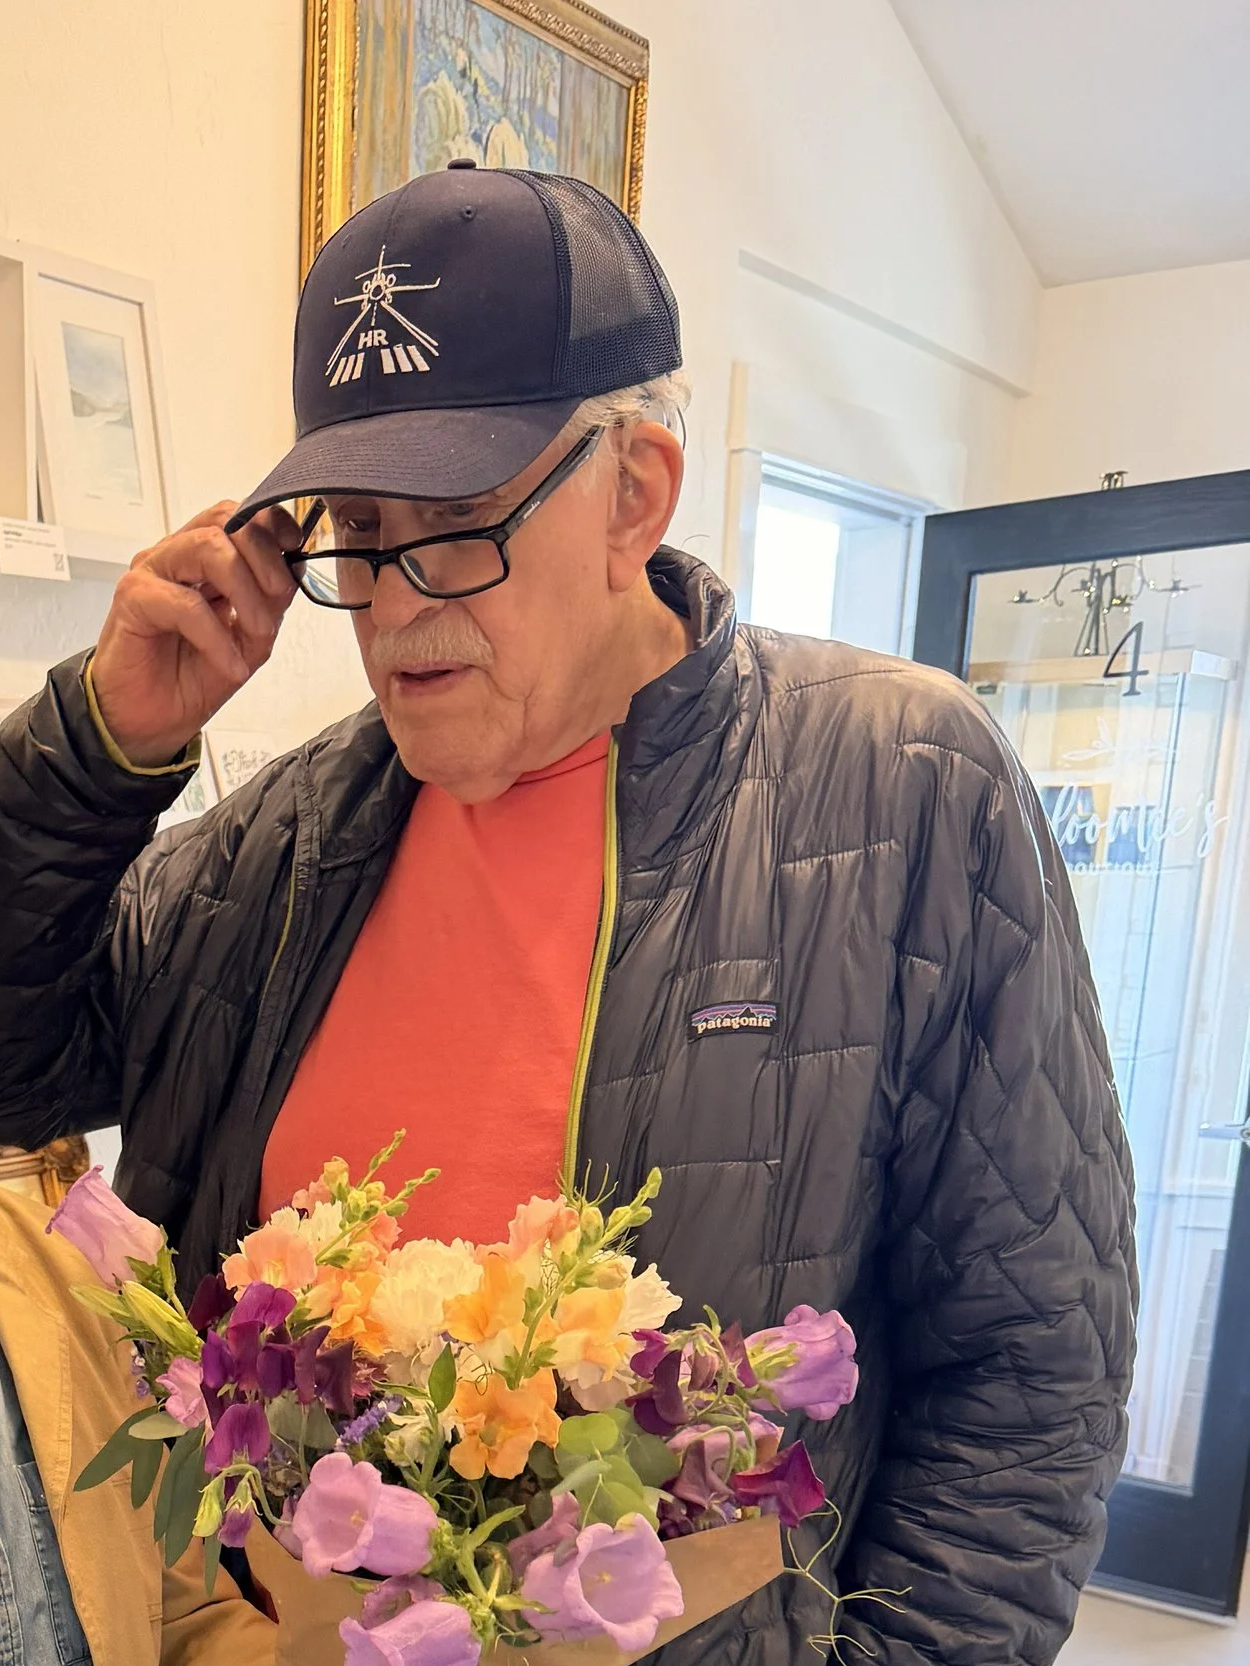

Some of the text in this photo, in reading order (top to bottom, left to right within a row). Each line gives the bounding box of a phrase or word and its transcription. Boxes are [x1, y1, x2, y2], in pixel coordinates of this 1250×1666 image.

[357, 329, 390, 350] HR
[1102, 620, 1149, 697] 4
[696, 1015, 772, 1034] patagonia
